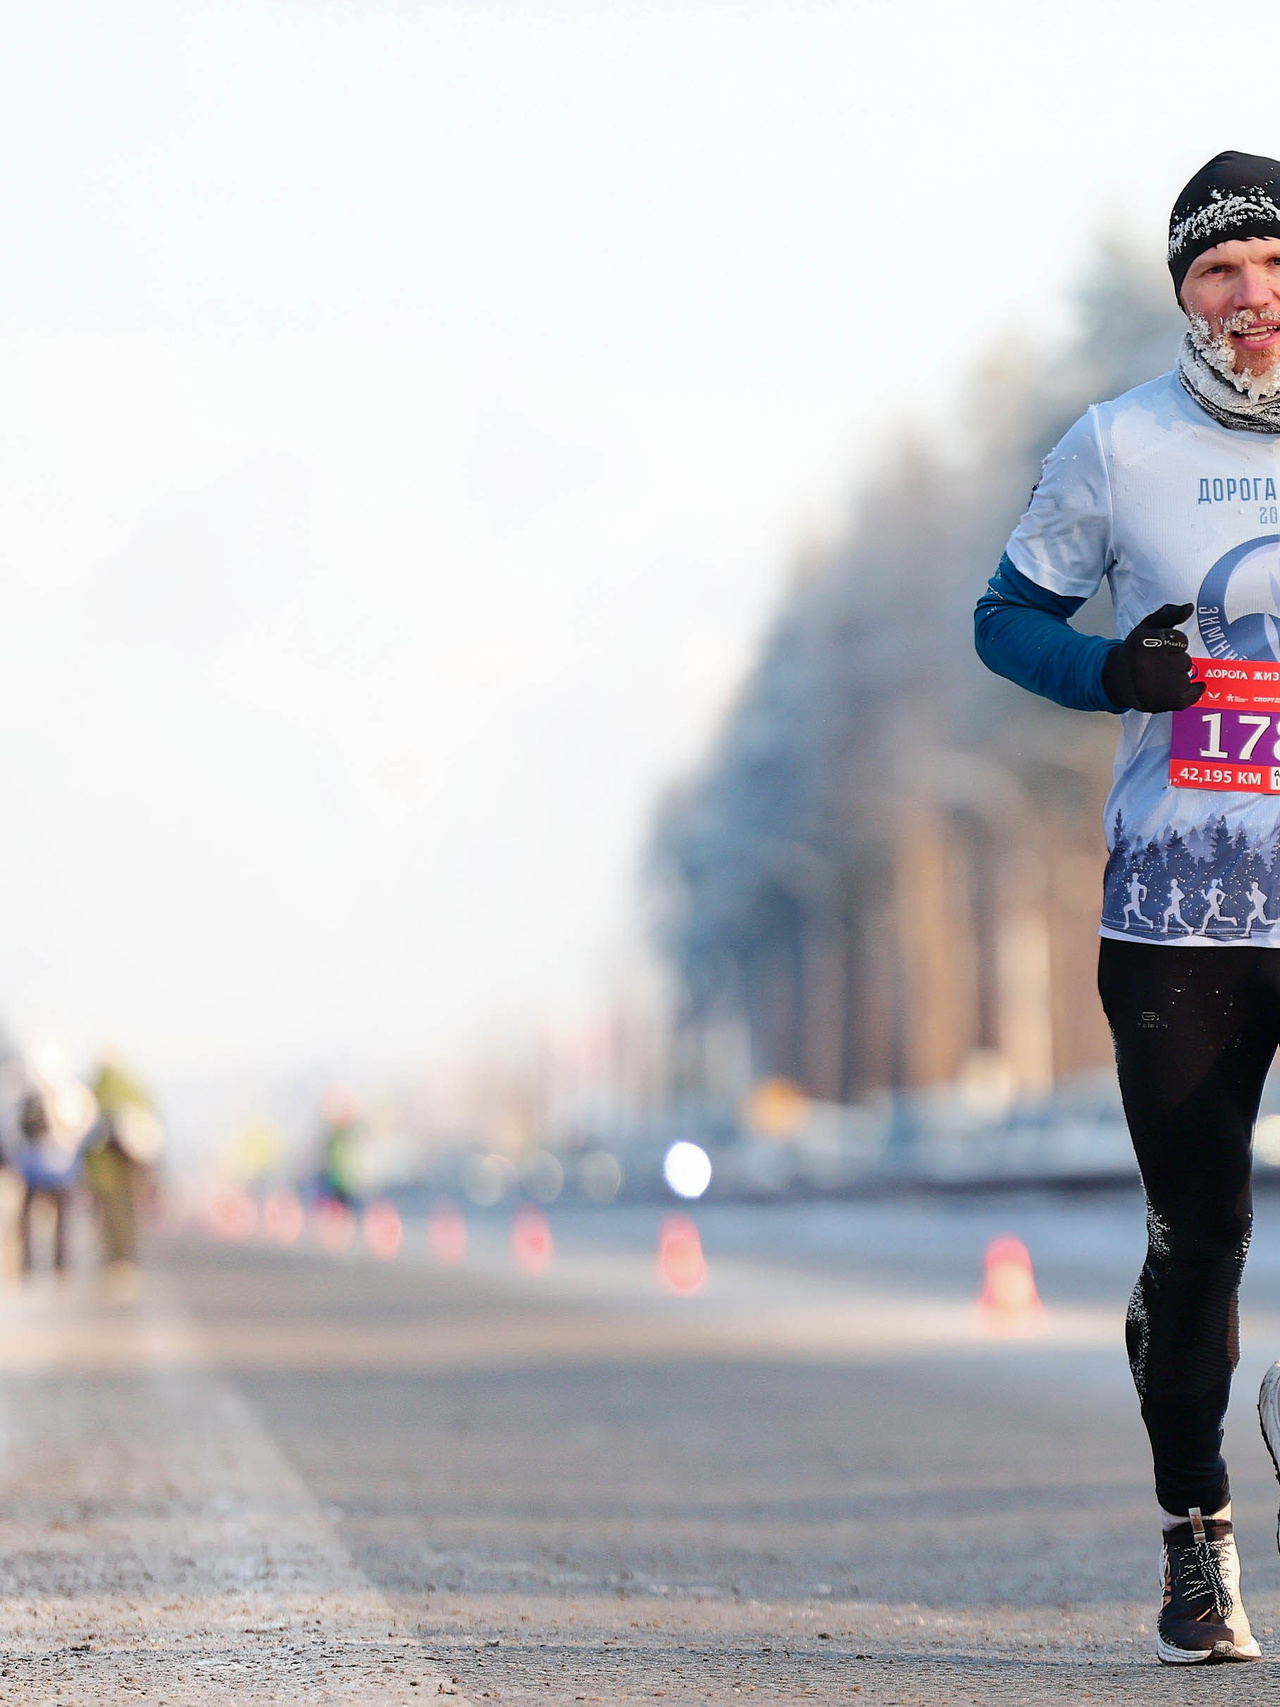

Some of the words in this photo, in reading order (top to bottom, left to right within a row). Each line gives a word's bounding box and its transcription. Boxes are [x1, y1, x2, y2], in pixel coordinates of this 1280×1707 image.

[1198, 477, 1277, 504] ДОРОГА
[1204, 668, 1249, 680] ДОРОГА
[1179, 767, 1233, 784] 42,195
[1237, 772, 1262, 785] КМ
